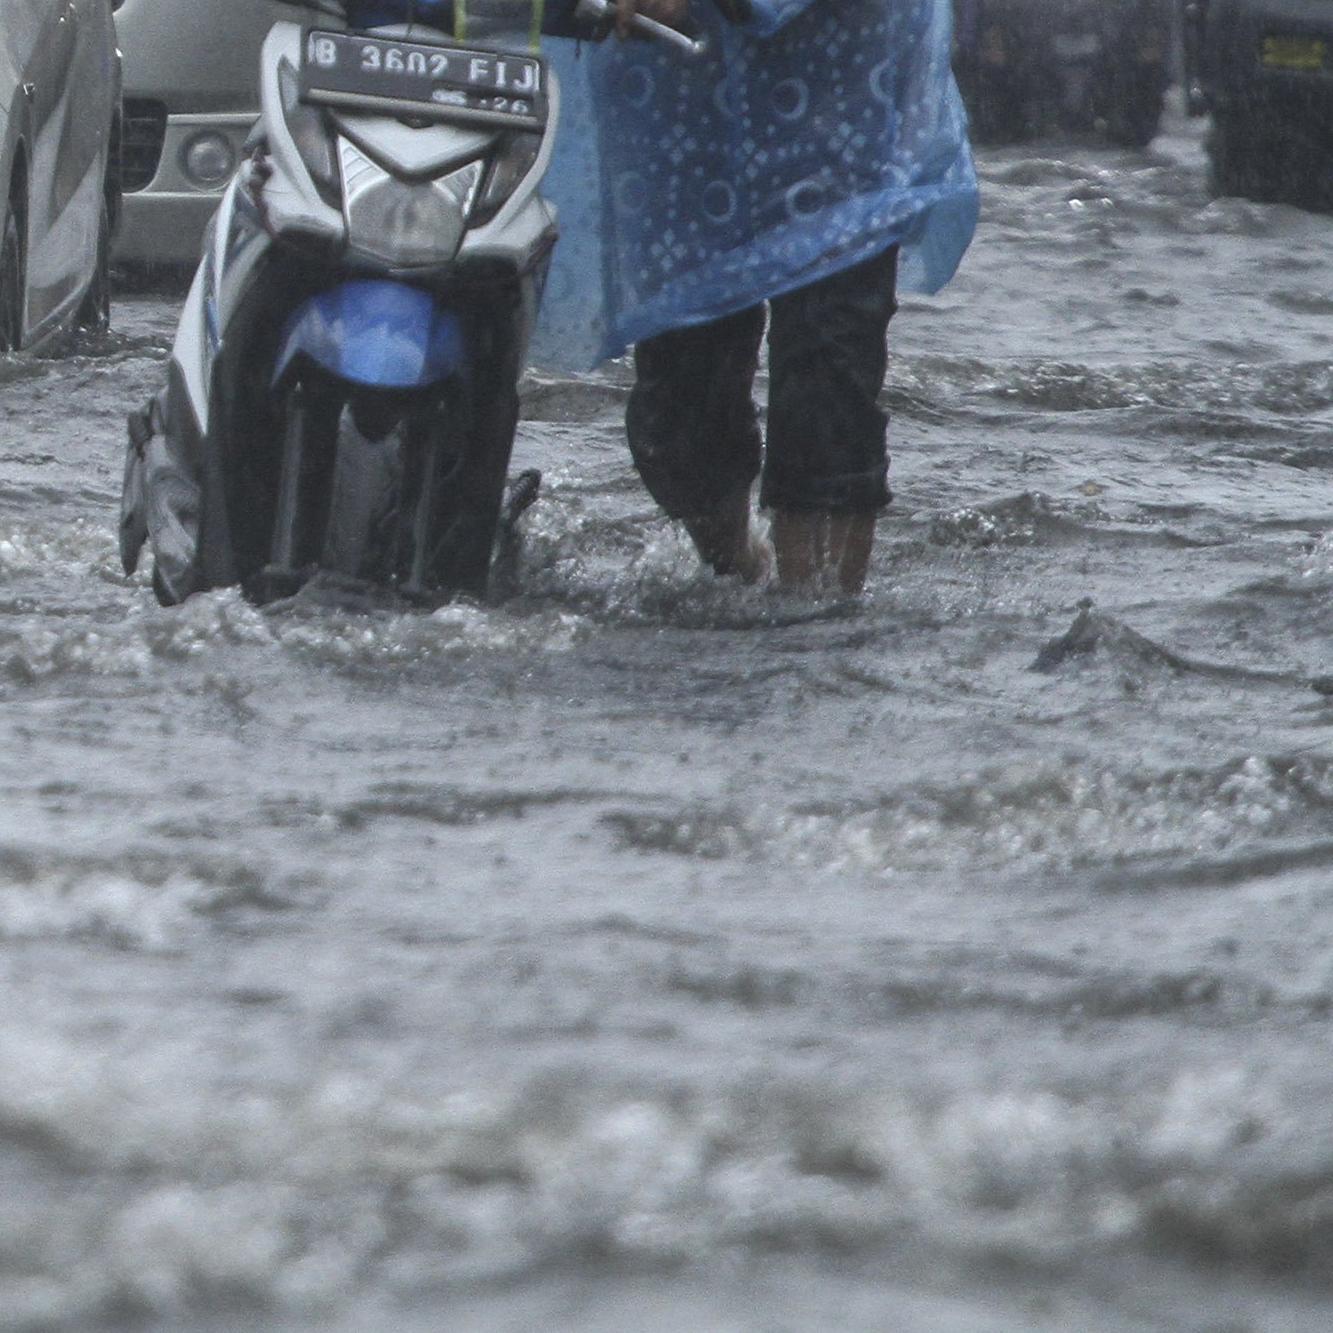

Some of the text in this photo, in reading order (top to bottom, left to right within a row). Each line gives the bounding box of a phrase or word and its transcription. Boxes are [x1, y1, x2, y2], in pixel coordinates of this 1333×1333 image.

[315, 38, 535, 91] B 3602 FIJ
